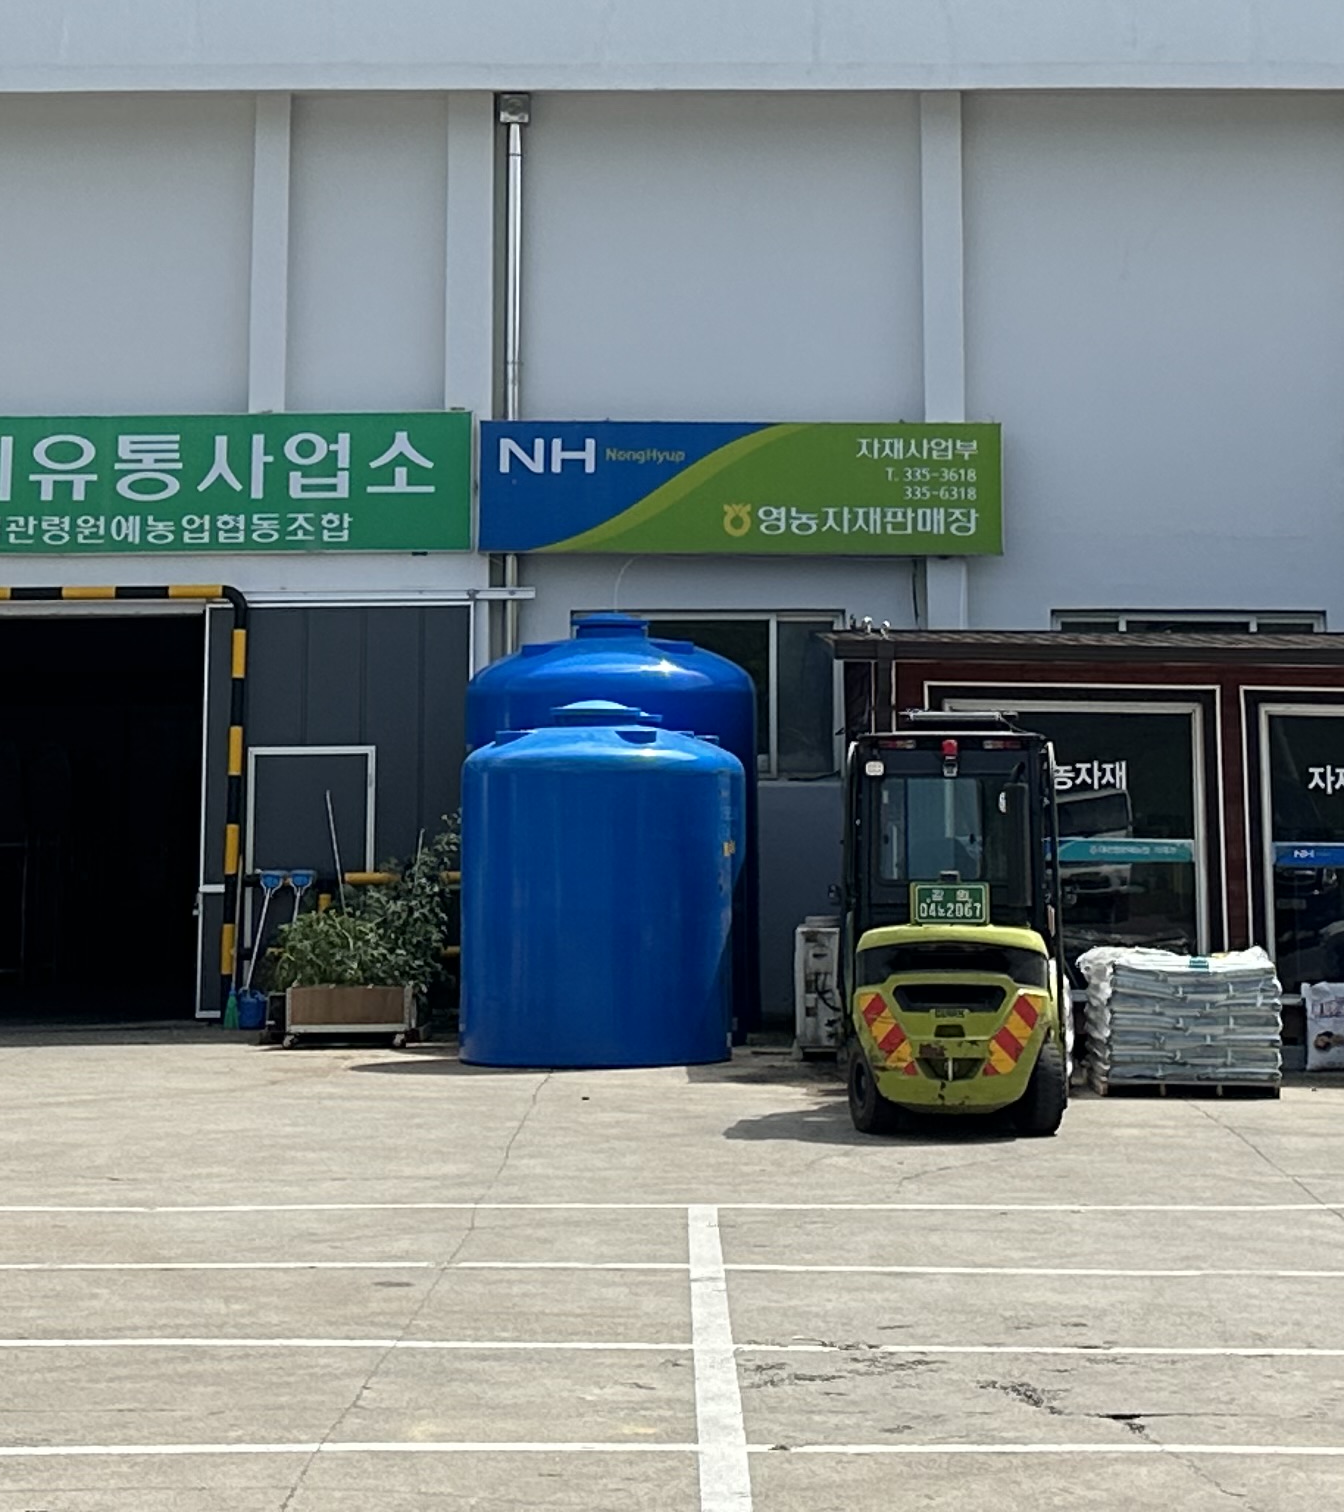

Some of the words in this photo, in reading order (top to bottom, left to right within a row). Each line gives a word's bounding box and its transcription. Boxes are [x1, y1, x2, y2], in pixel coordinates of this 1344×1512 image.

[499, 437, 596, 474] NH
[605, 448, 686, 464] NongHyup
[856, 437, 978, 461] 자재사업부
[885, 467, 899, 482] T.
[903, 467, 977, 482] 335-3618
[903, 486, 977, 500] 335-6318
[757, 505, 979, 536] 영농자재판매장
